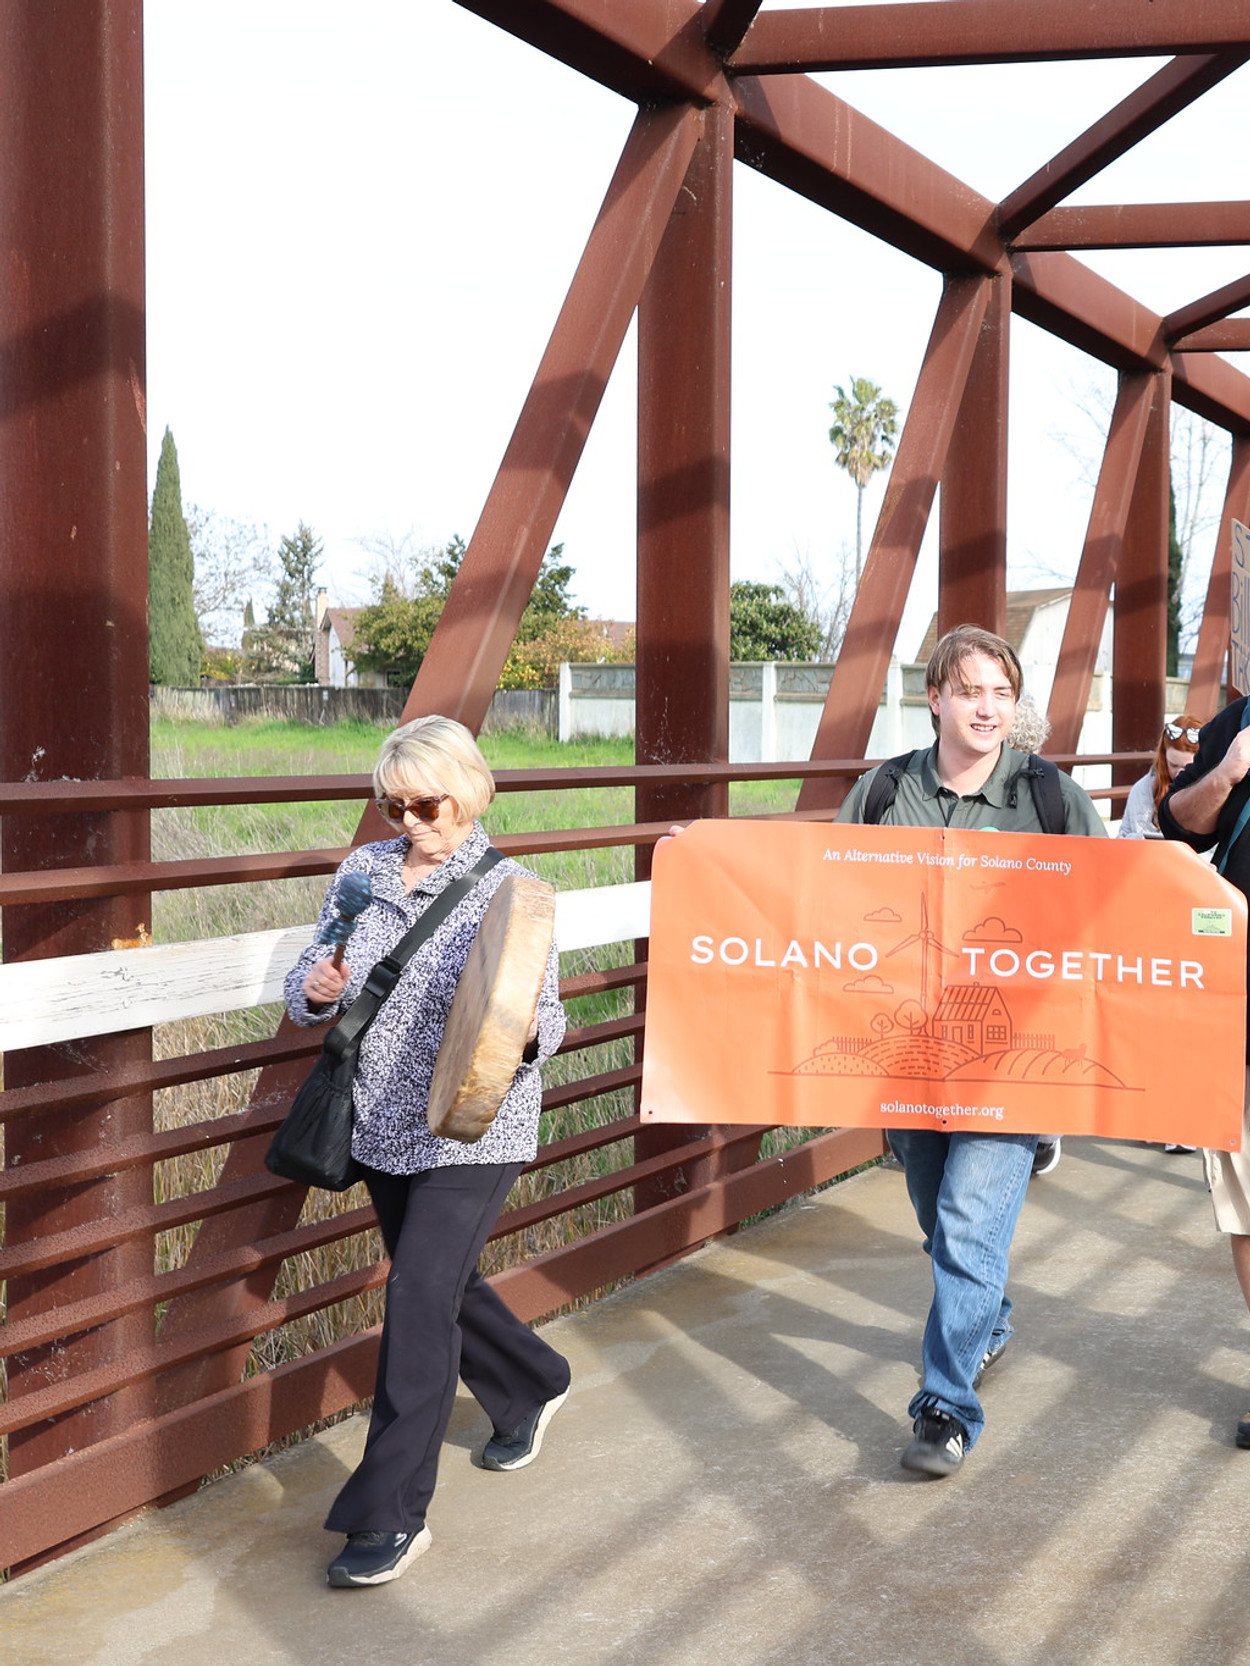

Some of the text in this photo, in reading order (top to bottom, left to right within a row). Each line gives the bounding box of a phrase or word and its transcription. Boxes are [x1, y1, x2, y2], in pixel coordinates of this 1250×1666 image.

[823, 848, 1072, 875] An Alternative Vision for Solano County
[690, 935, 1205, 989] SOLANO TOGETHER
[880, 1100, 1004, 1120] solanotogether.org
